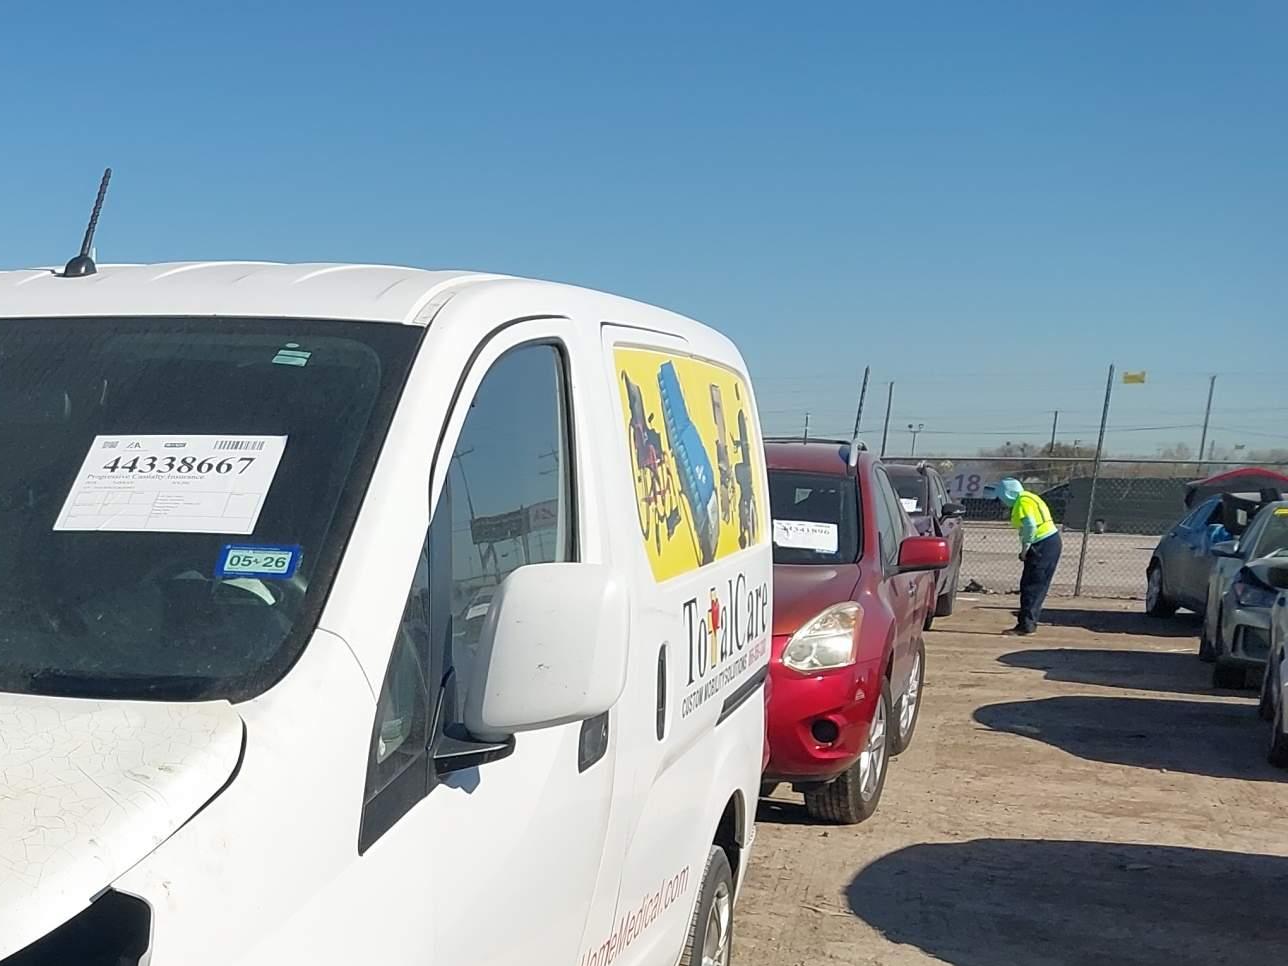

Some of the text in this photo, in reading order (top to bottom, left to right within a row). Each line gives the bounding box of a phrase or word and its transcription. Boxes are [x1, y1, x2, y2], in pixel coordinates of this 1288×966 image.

[103, 456, 256, 475] 44338667
[229, 555, 287, 568] 05 26
[682, 686, 704, 719] CUSTOM
